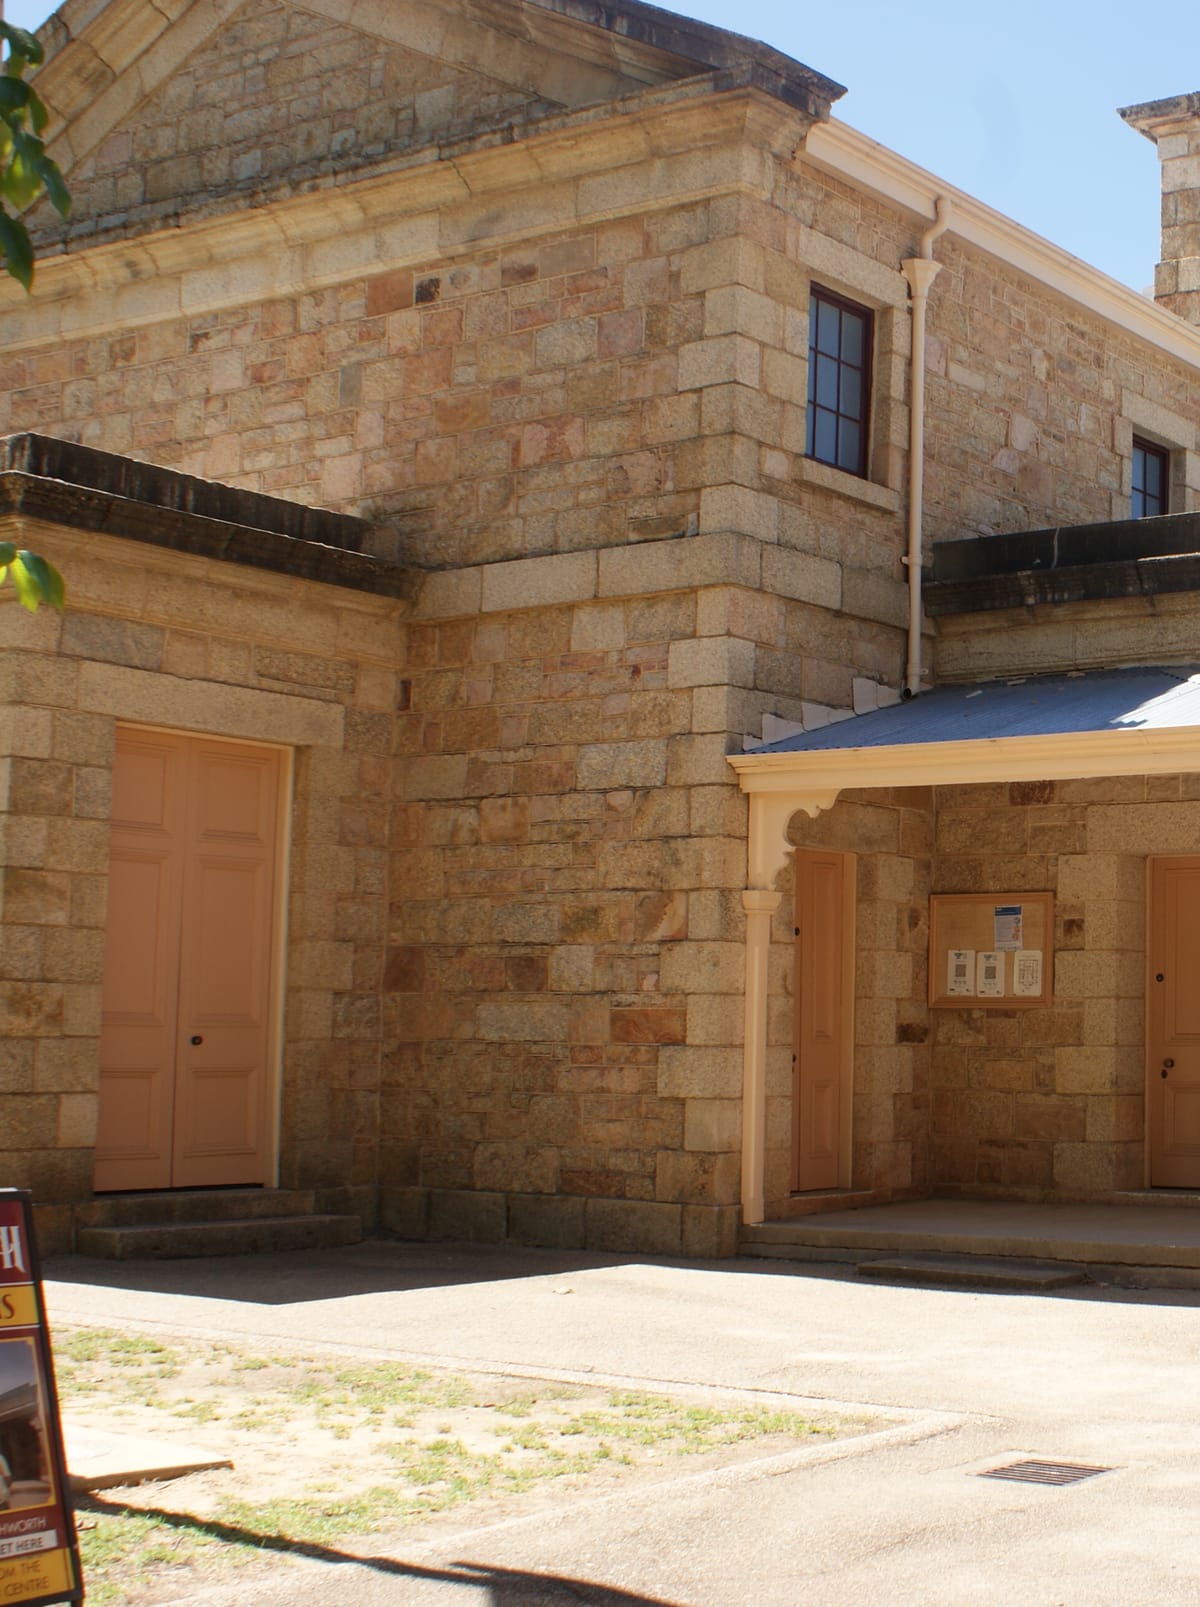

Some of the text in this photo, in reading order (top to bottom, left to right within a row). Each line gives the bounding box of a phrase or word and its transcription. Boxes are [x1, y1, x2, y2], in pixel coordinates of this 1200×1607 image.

[16, 1537, 44, 1551] HERE
[20, 1560, 41, 1575] THE
[5, 1577, 48, 1595] CENTRE
